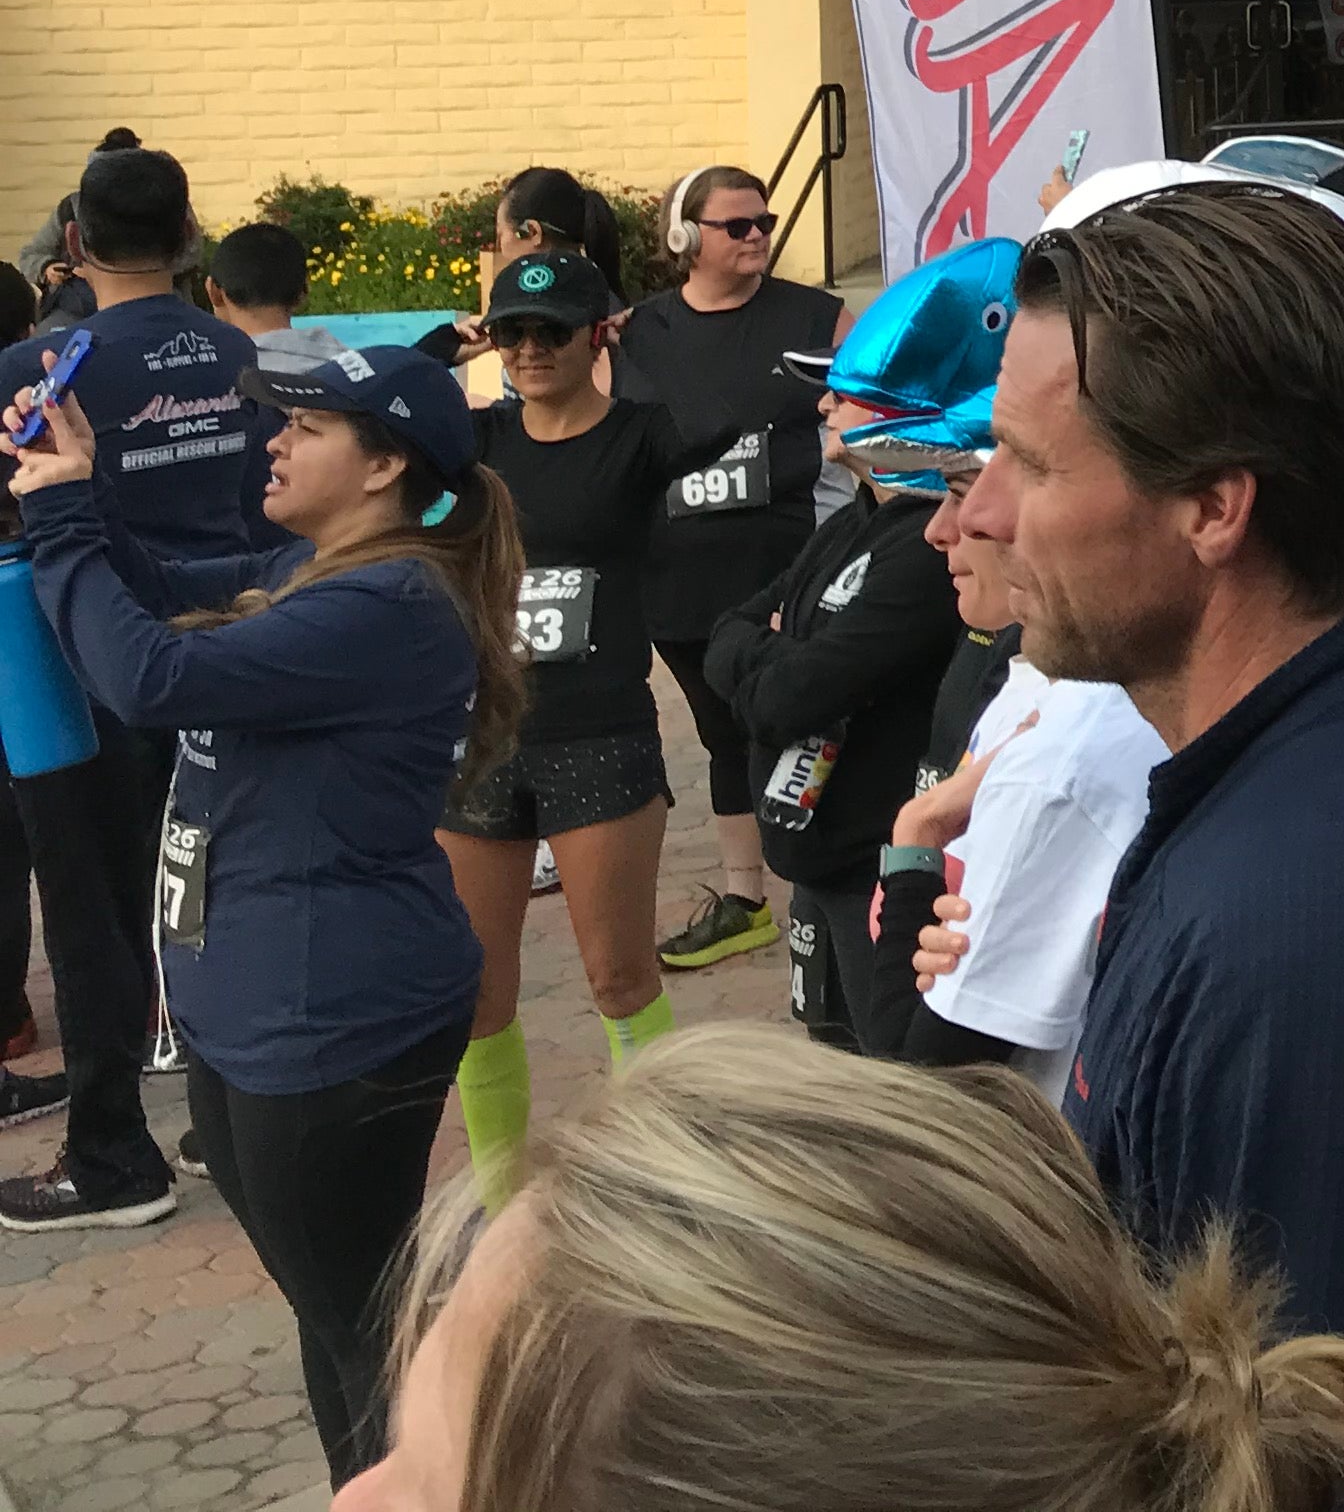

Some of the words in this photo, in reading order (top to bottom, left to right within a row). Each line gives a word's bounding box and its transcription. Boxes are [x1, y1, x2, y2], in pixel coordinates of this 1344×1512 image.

[682, 465, 748, 507] 691
[540, 568, 583, 587] 26
[168, 822, 200, 850] 26
[791, 917, 816, 943] 26
